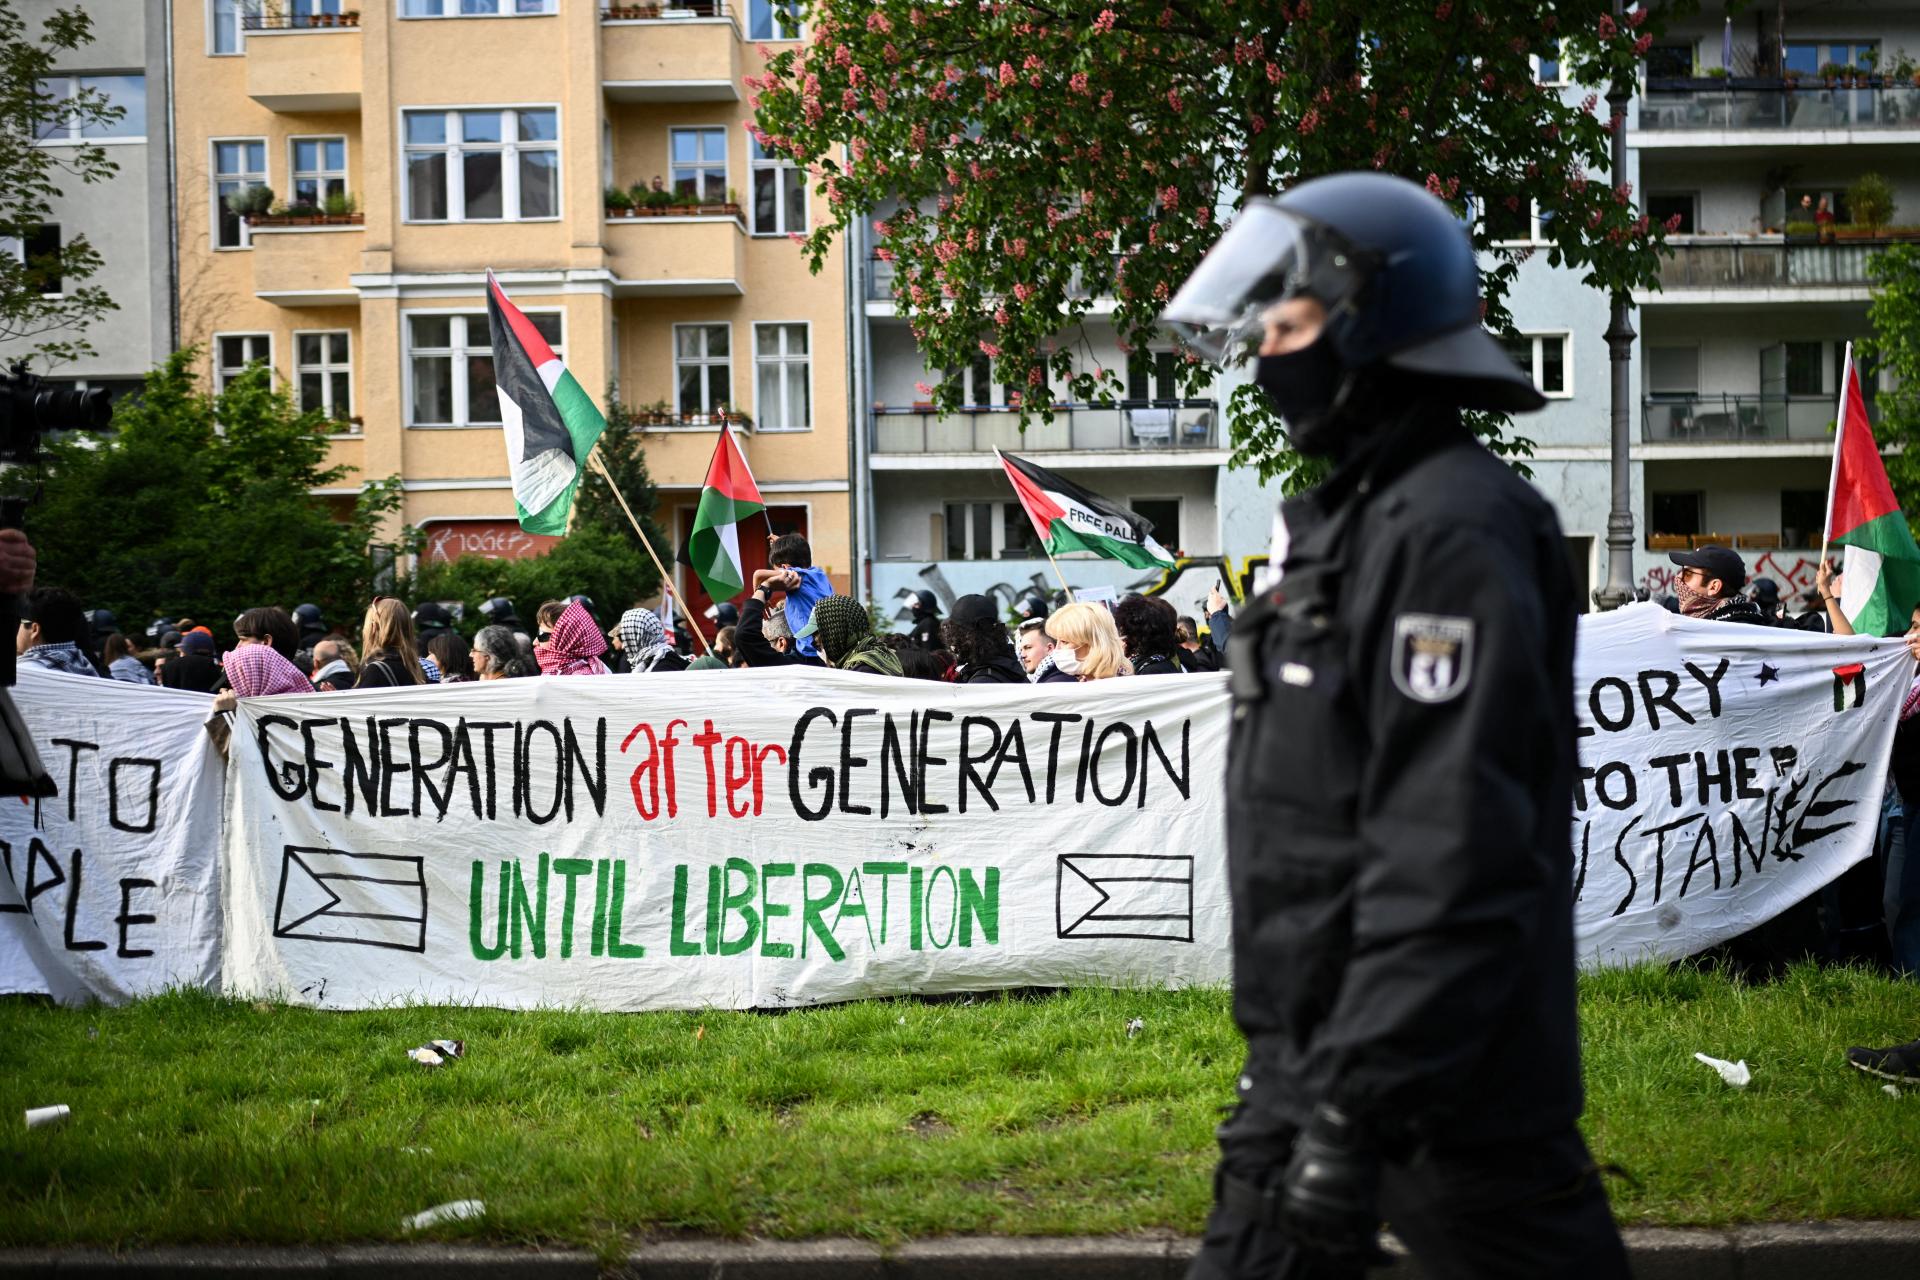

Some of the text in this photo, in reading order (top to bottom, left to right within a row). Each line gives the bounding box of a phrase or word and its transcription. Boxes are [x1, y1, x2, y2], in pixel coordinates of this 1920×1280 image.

[1070, 508, 1101, 527] FREE
[1576, 658, 1729, 735] ORY
[51, 738, 161, 833] TO
[257, 706, 1191, 824] GENERATION after GENERATION
[1573, 760, 1637, 811] TO
[470, 853, 1000, 961] UNTIL LIBERATION
